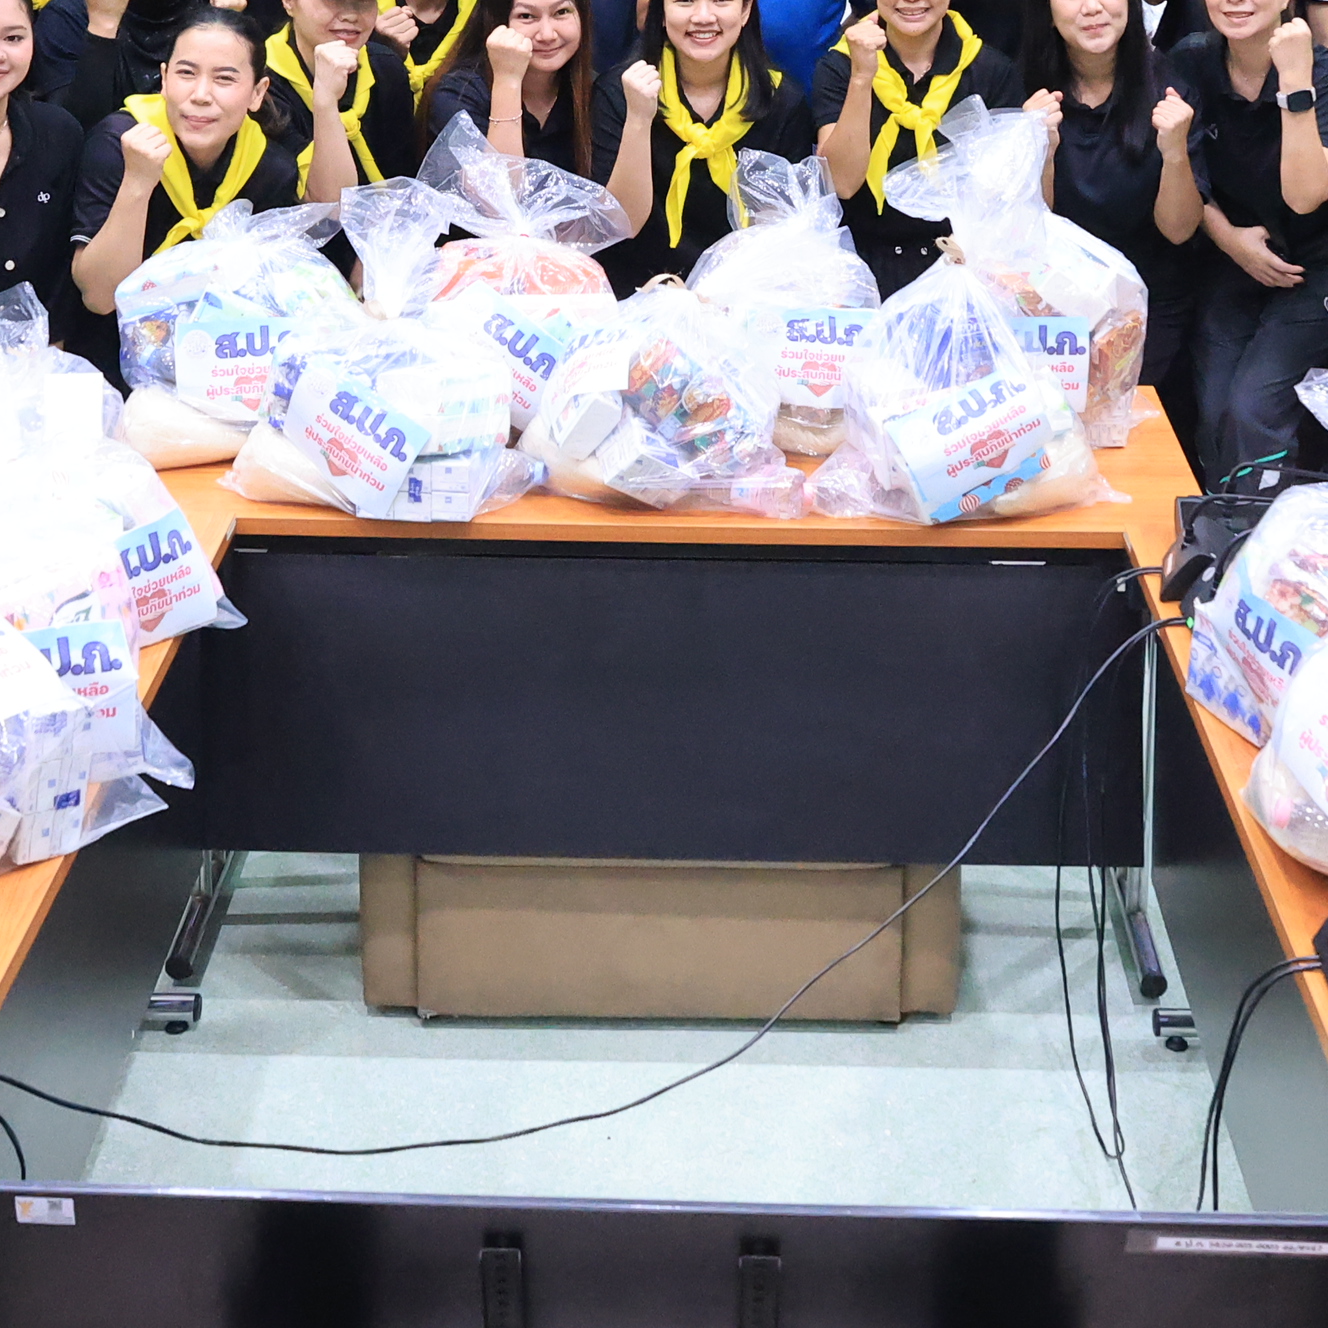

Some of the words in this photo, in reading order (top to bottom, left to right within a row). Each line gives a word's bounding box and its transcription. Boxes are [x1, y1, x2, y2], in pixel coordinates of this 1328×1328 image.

[215, 325, 291, 359] ส.ป.
[483, 313, 557, 382] ส.ป.ก
[315, 412, 389, 472] ร่วมใจช่วยเหลือ
[329, 390, 408, 463] ส.ป.ก.
[947, 418, 1041, 478] ผู้ประสบภัยน้ำท่วม
[304, 425, 385, 492] ผู้ประสบภัยน้ำท่วม
[131, 565, 192, 600] ใจช่วยเหลือ
[41, 635, 123, 678] ป.ก.
